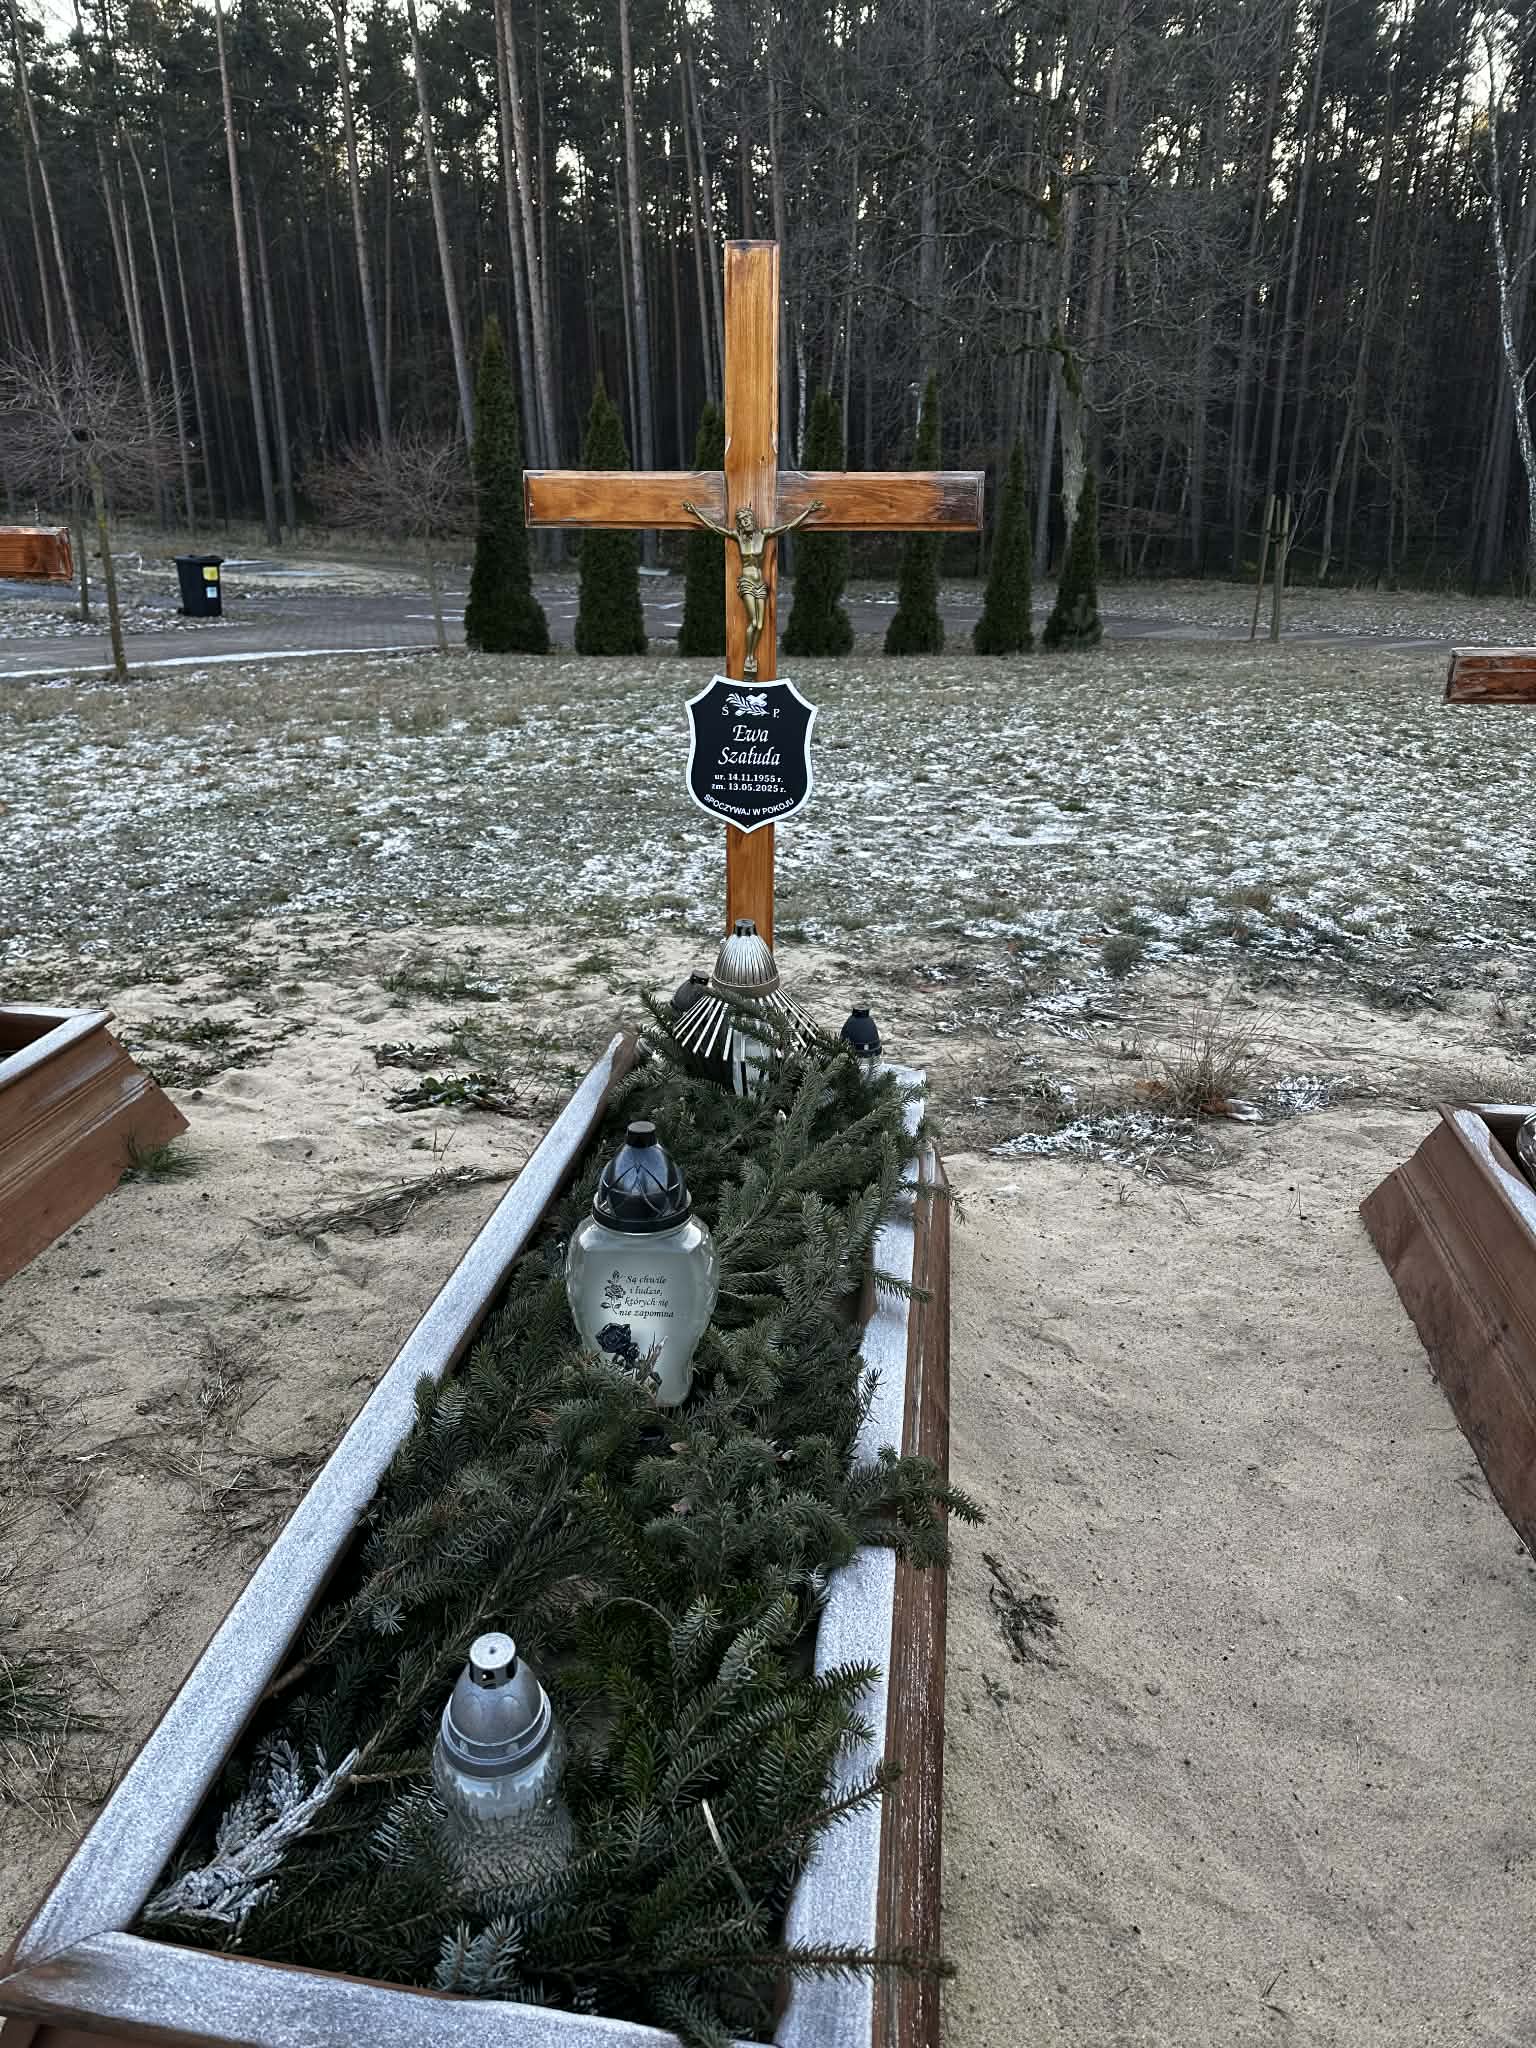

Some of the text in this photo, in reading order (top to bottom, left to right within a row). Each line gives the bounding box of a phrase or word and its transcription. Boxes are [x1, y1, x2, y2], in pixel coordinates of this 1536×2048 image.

[732, 724, 769, 743] Ewa
[717, 745, 781, 766] Szałuda
[714, 773, 726, 781] ur.
[728, 773, 776, 783] 14.11.1955
[728, 782, 779, 793] 13.05.2025
[779, 785, 787, 793] r.
[703, 793, 795, 816] SPOCZYWAJ W POKOJU
[619, 1309, 632, 1317] nie
